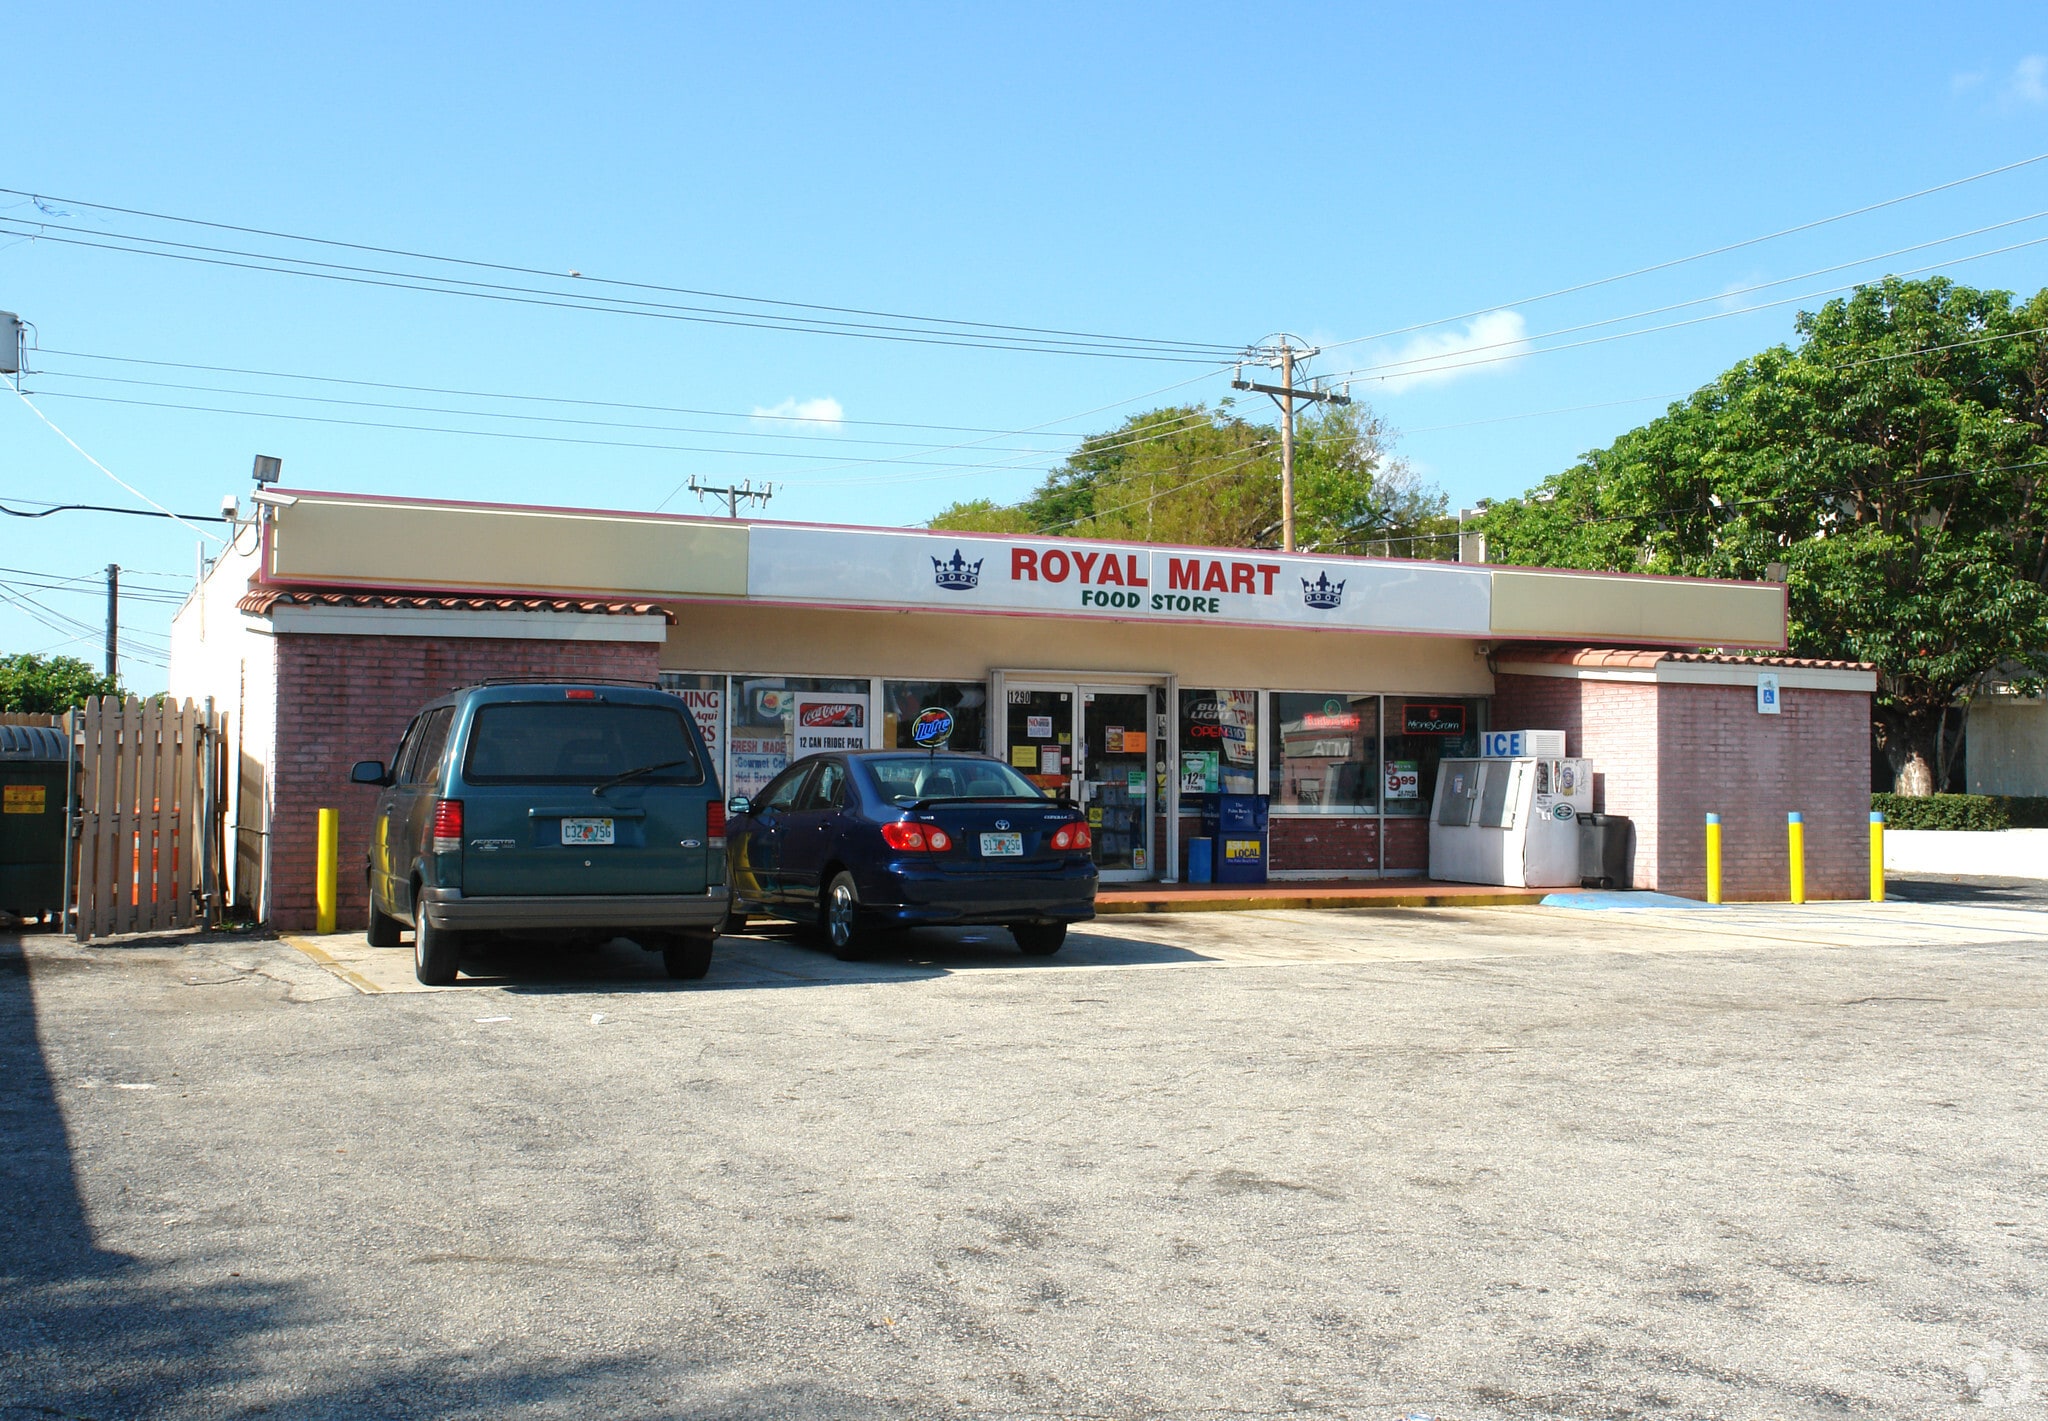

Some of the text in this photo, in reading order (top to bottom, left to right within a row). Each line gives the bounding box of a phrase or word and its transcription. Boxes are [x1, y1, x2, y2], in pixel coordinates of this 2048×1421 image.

[1011, 547, 1281, 596] ROYAL MART
[1081, 590, 1220, 614] FOOD STORE
[669, 690, 719, 709] HING
[1009, 691, 1030, 704] 1290
[1197, 703, 1226, 711] BUD
[694, 711, 719, 723] Aqui
[1190, 725, 1229, 738] OPEN
[1407, 718, 1459, 732] MoneyGram
[731, 740, 758, 753] FRESH
[762, 741, 786, 754] MADE
[800, 737, 864, 750] 12 CAN FRIDGE PACK
[1312, 742, 1350, 757] ATM
[1485, 733, 1520, 756] ICE
[1234, 848, 1260, 858] LOCAL
